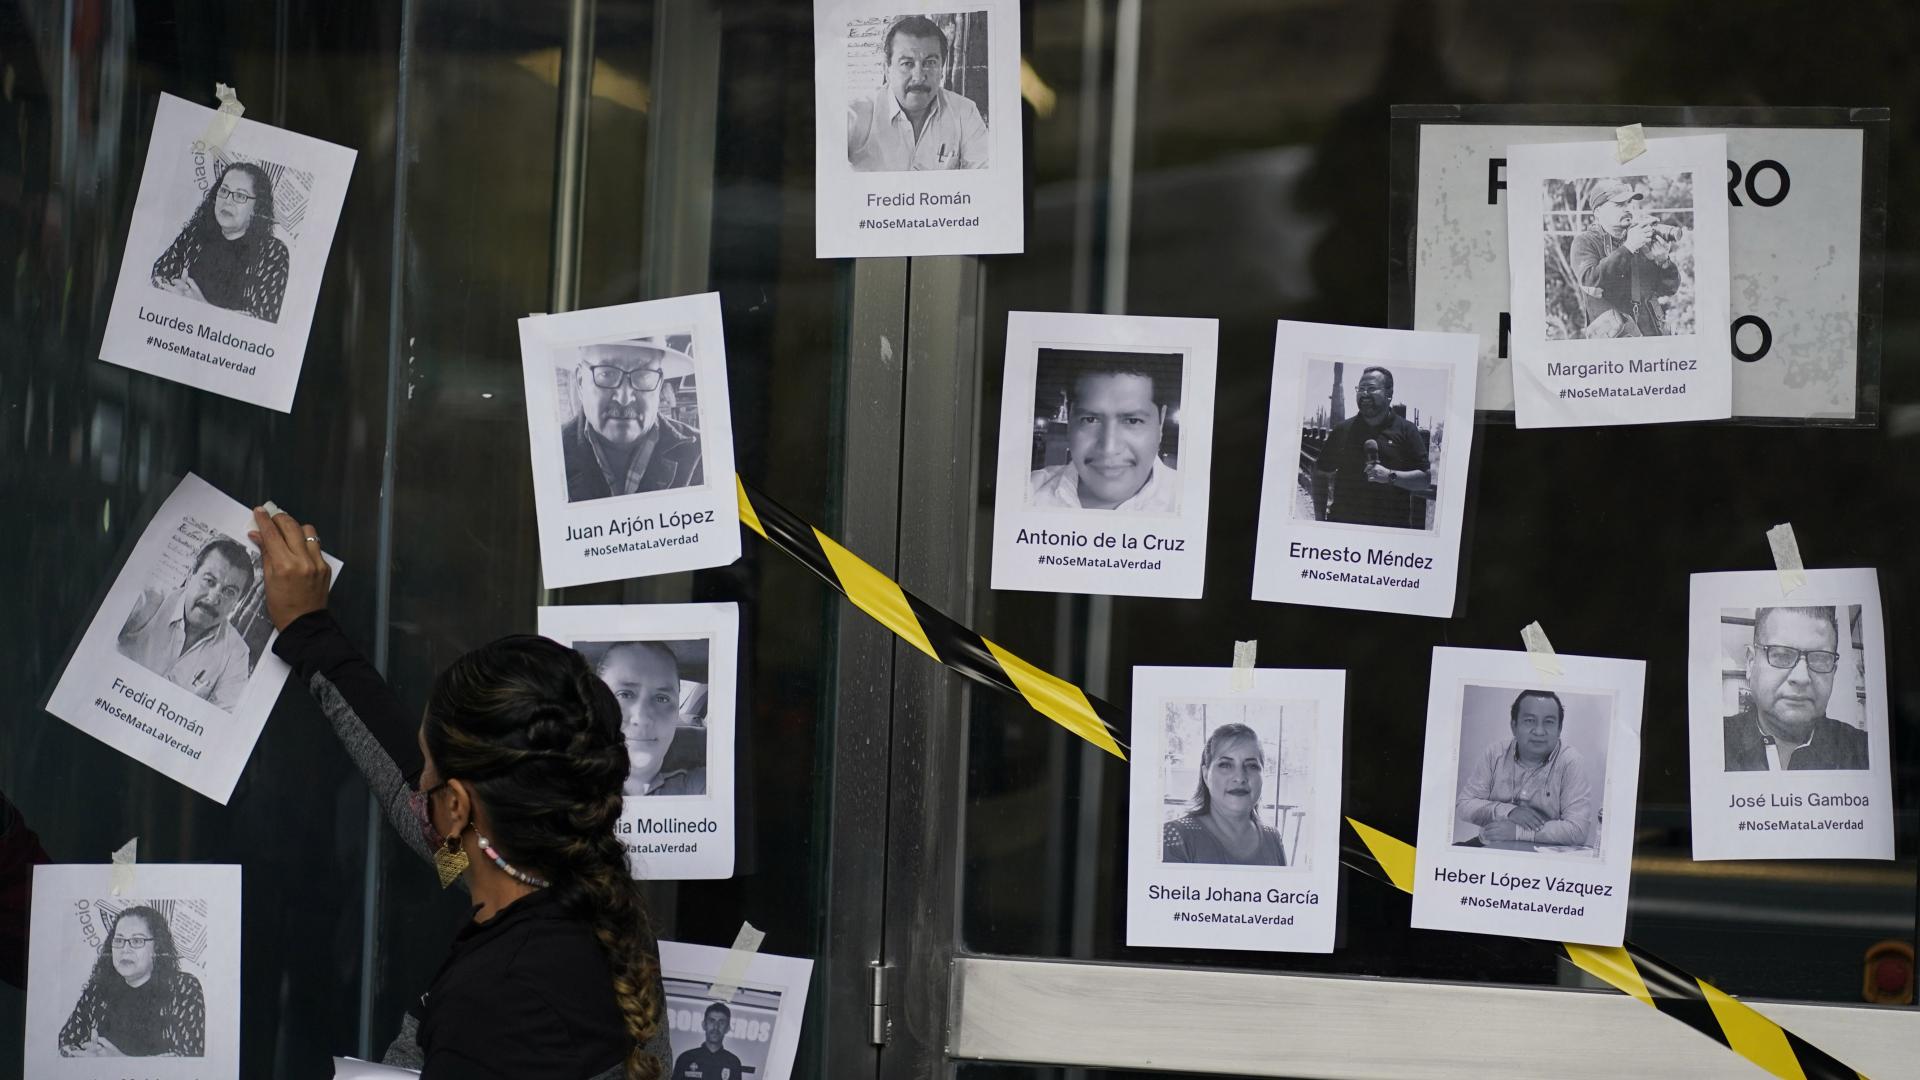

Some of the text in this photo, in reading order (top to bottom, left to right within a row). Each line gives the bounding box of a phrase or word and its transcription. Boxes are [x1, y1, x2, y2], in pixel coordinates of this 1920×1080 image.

[867, 191, 971, 207] Fredid Román
[859, 216, 980, 229] #NoSeMataLaVerdad
[138, 306, 275, 358] Lourdes Maldonado
[146, 335, 257, 376] #NoSeMataLaVerdad
[1547, 358, 1697, 378] Margarito Martínez
[1559, 384, 1686, 399] #NoSeMataLaVerdad
[565, 510, 715, 542] Juan Arjón López
[584, 533, 699, 557] #NoSeMataLaVerdad
[1016, 528, 1185, 551] Antonio de la Cruz
[1038, 555, 1161, 570] #NoSeMataLaVerdad
[1289, 542, 1433, 570] Ernesto Méndez
[1300, 569, 1420, 589] #NoSeMataLaVerdad
[111, 677, 204, 737] Fredid Román
[94, 697, 202, 760] #NoSeMataLaVerdad
[1729, 792, 1870, 808] José Luis Gamboa
[637, 817, 718, 834] Mollinedo
[1738, 819, 1864, 831] #NoSeMataLaVerdad
[1434, 867, 1613, 897] Heber López Vázquez
[1148, 884, 1319, 905] Sheila Johana García
[1460, 896, 1584, 917] #NoSeMataLaVerdad
[1173, 912, 1294, 926] #NoSeMataLaVerdad
